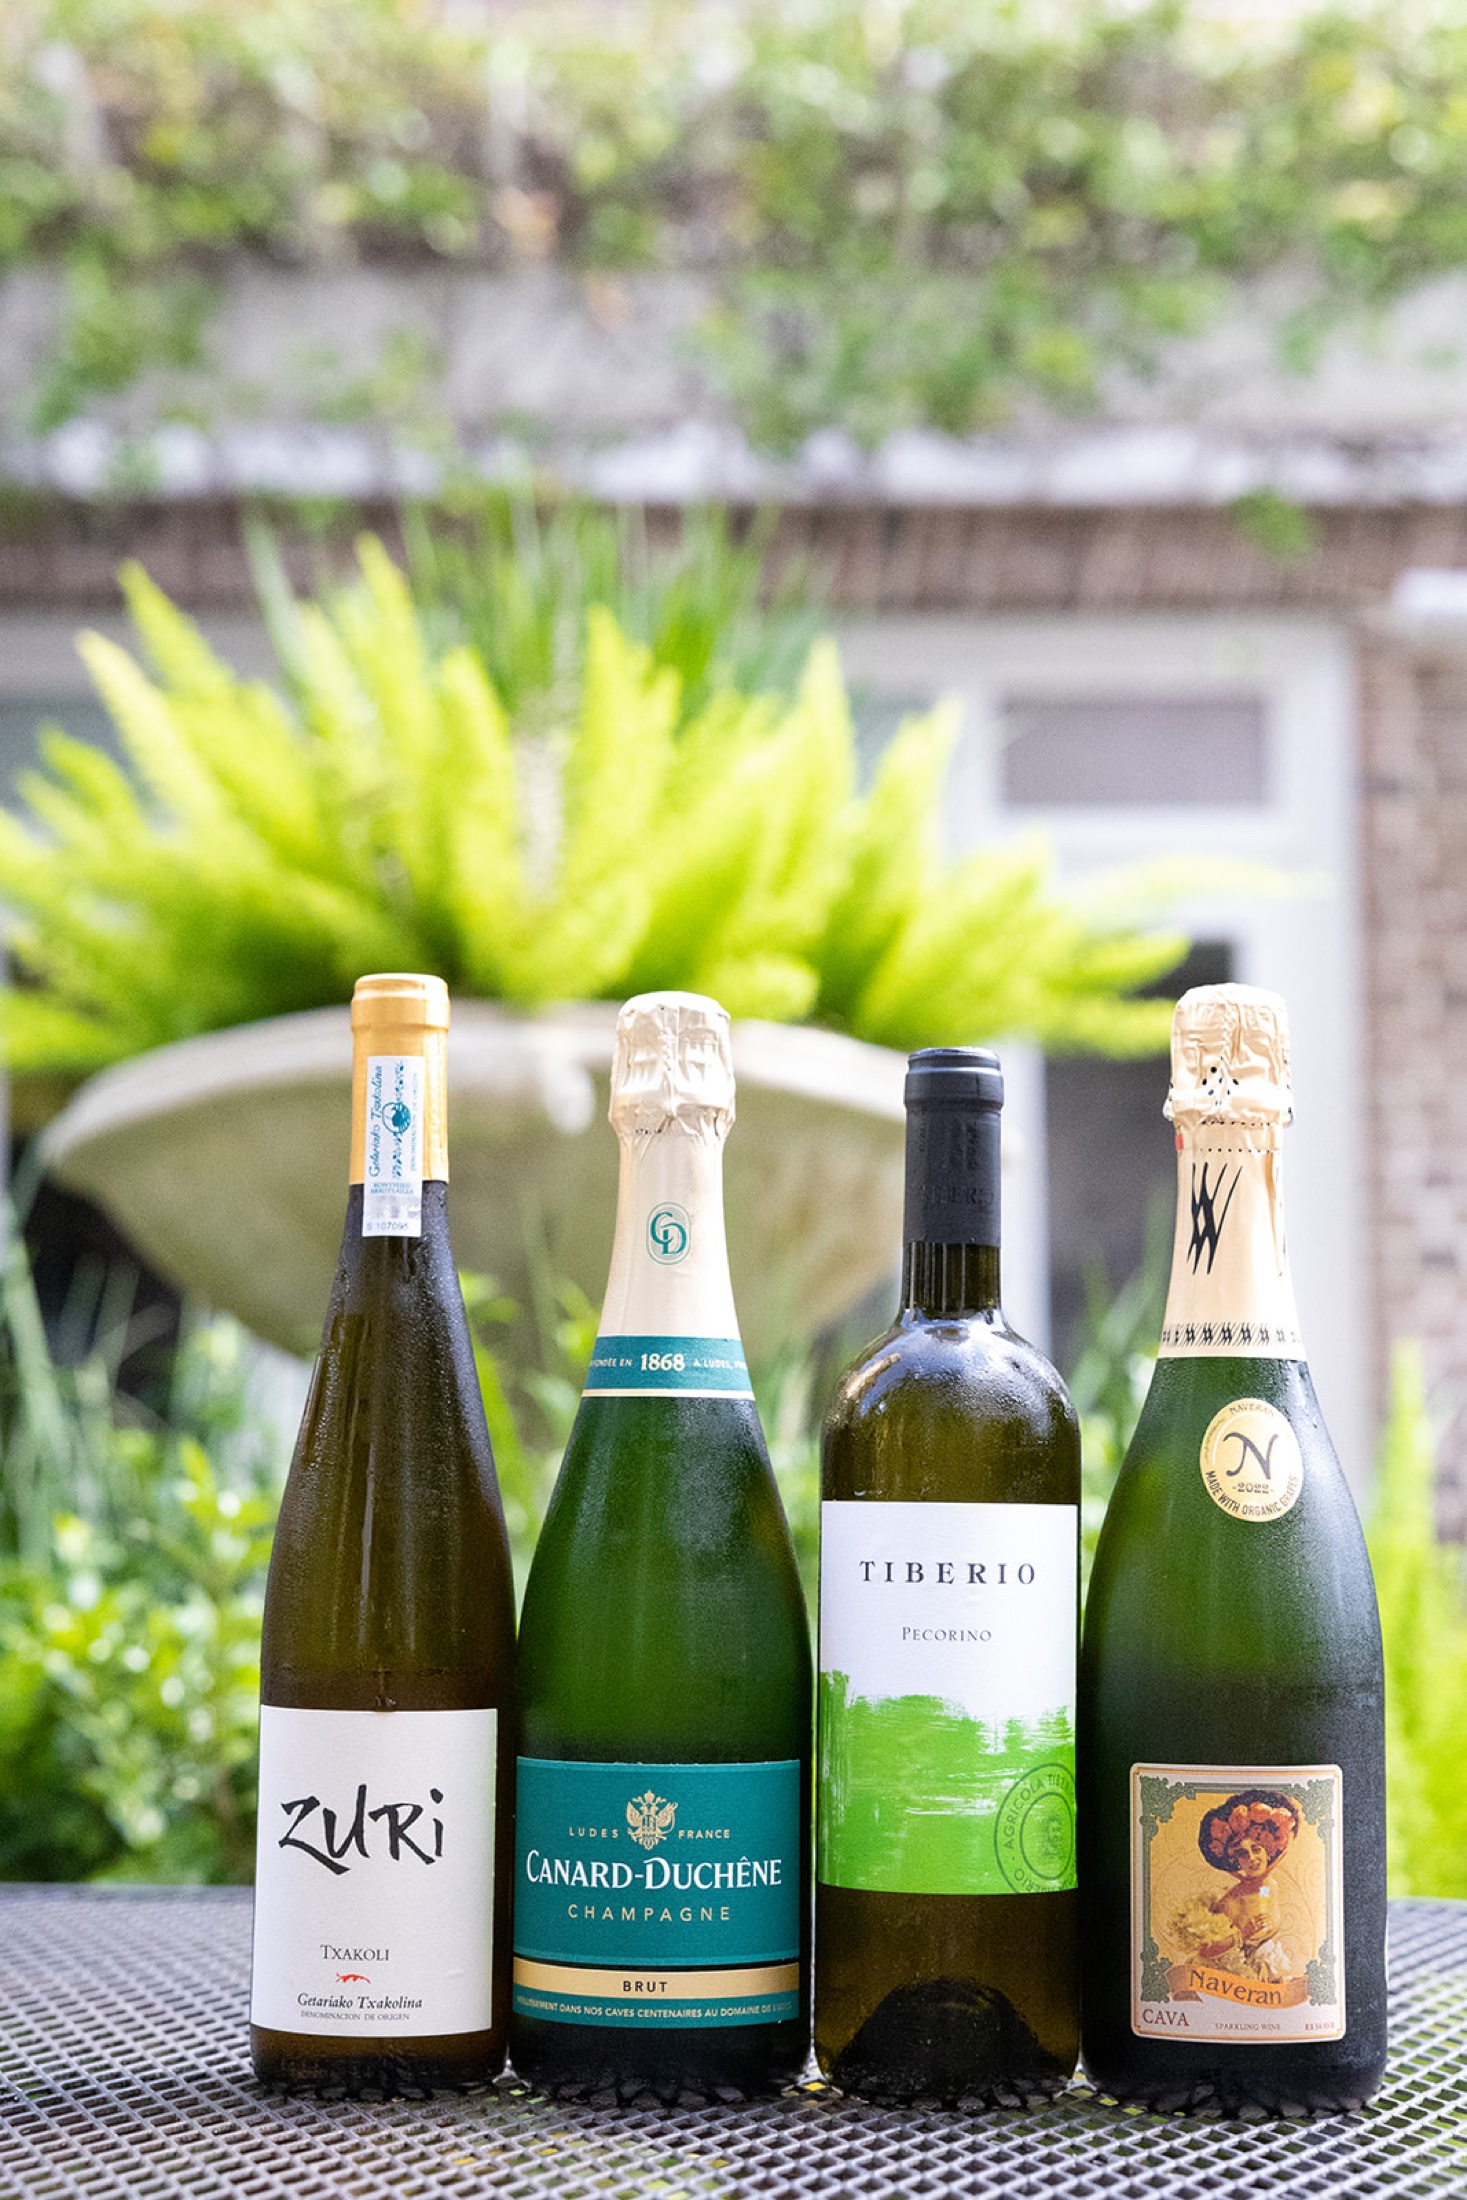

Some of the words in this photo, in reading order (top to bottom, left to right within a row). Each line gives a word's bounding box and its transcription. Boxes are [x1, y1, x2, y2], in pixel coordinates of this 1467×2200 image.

[619, 1357, 633, 1368] EN
[640, 1353, 686, 1372] 1868
[1222, 1432, 1279, 1480] N
[1205, 1470, 1223, 1497] MADE
[1217, 1493, 1241, 1513] WITH
[1241, 1501, 1283, 1517] ORGANIC
[1279, 1474, 1299, 1507] GRAPES
[859, 1560, 1036, 1585] TIBERIO
[1003, 1778, 1046, 1850] AGRICOLA
[568, 1826, 619, 1839] LUDES
[678, 1829, 731, 1839] FRANCE
[567, 1903, 730, 1921] CHAMPAGNE
[622, 1980, 668, 1993] BRUT
[1189, 1968, 1283, 2006] Naveran
[297, 1993, 353, 2009] Getariako
[357, 1995, 423, 2010] Txakolina
[560, 2003, 582, 2014] DANS
[583, 2005, 603, 2016] NOS
[604, 2008, 635, 2018] CAVES
[637, 2008, 702, 2018] CENTENAIRES
[703, 2008, 719, 2018] AU
[720, 2005, 760, 2017] DOMAINE
[364, 2012, 375, 2021] DE
[1142, 2008, 1190, 2027] CAVA
